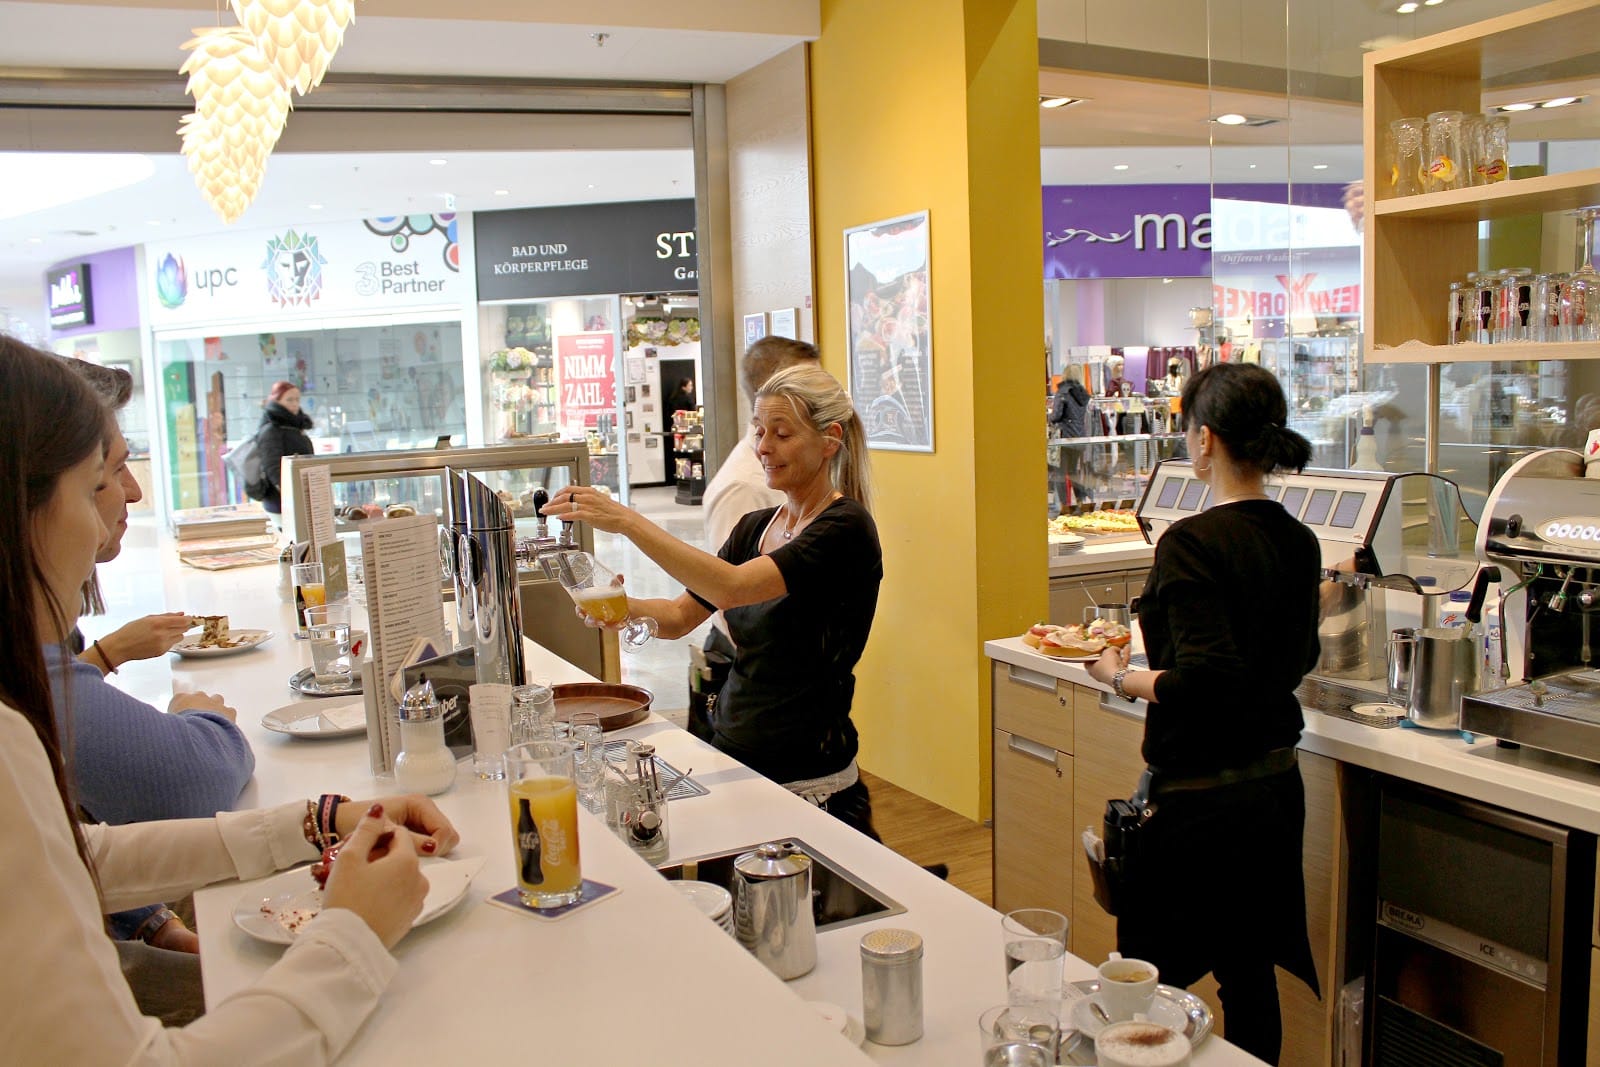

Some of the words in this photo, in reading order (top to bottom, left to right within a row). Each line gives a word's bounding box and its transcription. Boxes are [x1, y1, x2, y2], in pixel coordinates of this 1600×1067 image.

[511, 246, 537, 257] BAD
[539, 243, 568, 256] UND
[655, 231, 698, 259] ST
[381, 260, 420, 277] Best
[493, 259, 589, 275] KÖRPERPFLEGE
[195, 267, 238, 297] upc
[382, 279, 445, 295] Partner
[563, 354, 607, 380] NIMM
[564, 382, 605, 407] ZAHL
[1479, 942, 1496, 958] ICE
